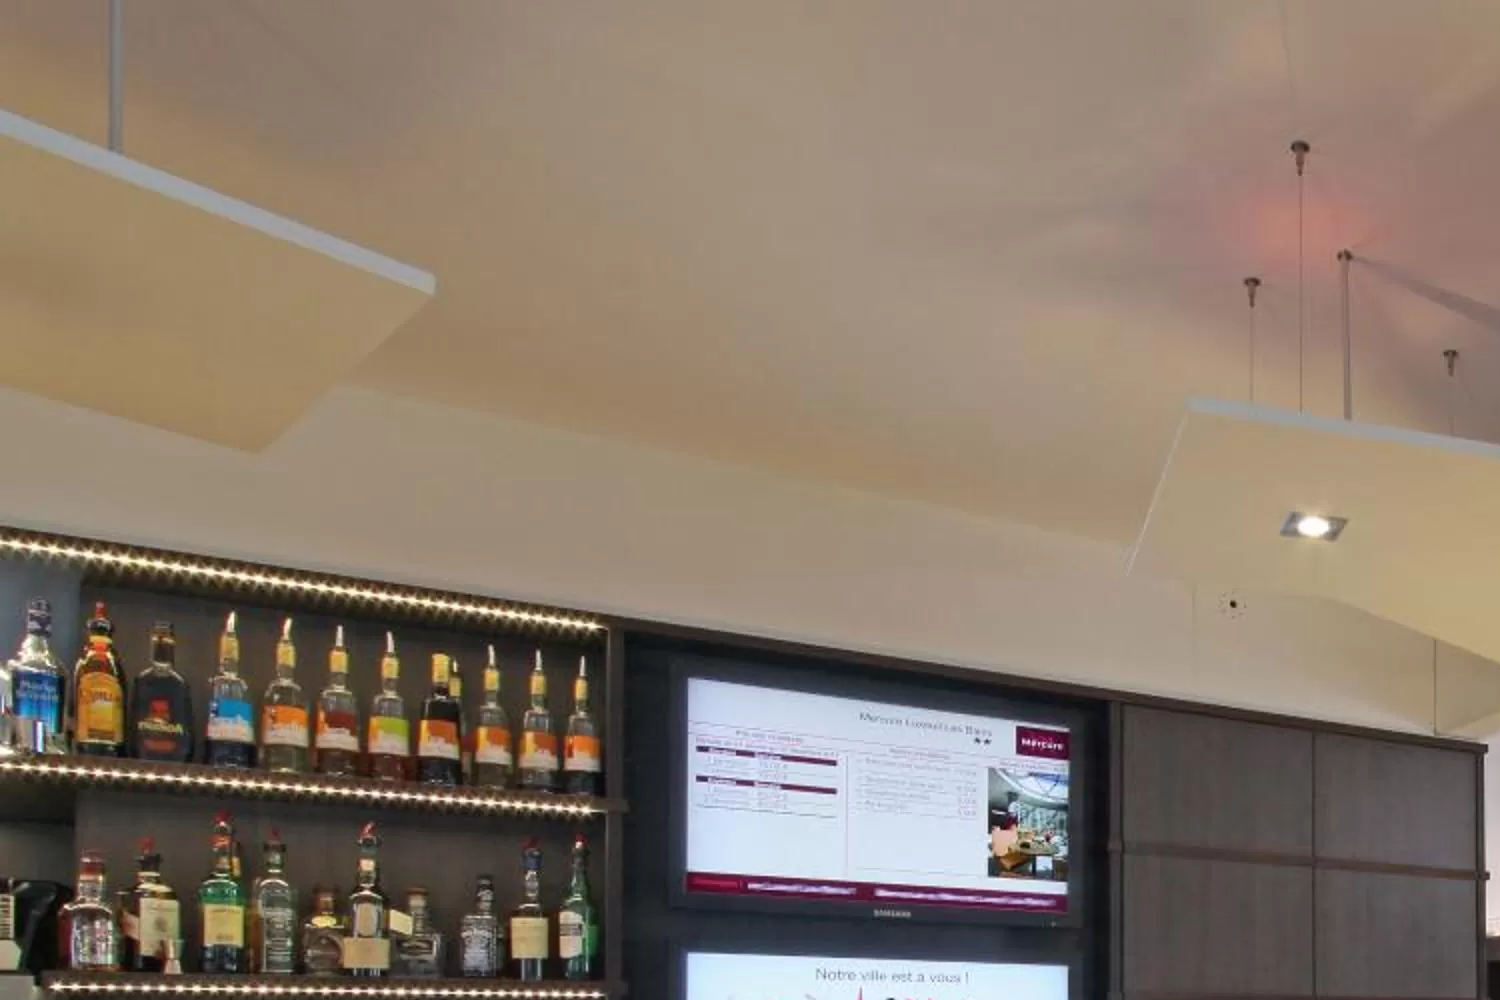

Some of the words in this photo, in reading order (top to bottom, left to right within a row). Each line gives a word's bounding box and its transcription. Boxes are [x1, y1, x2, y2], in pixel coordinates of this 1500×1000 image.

[815, 967, 857, 982] Notre
[861, 969, 887, 981] ville
[891, 972, 913, 983] est
[928, 974, 961, 983] vous
